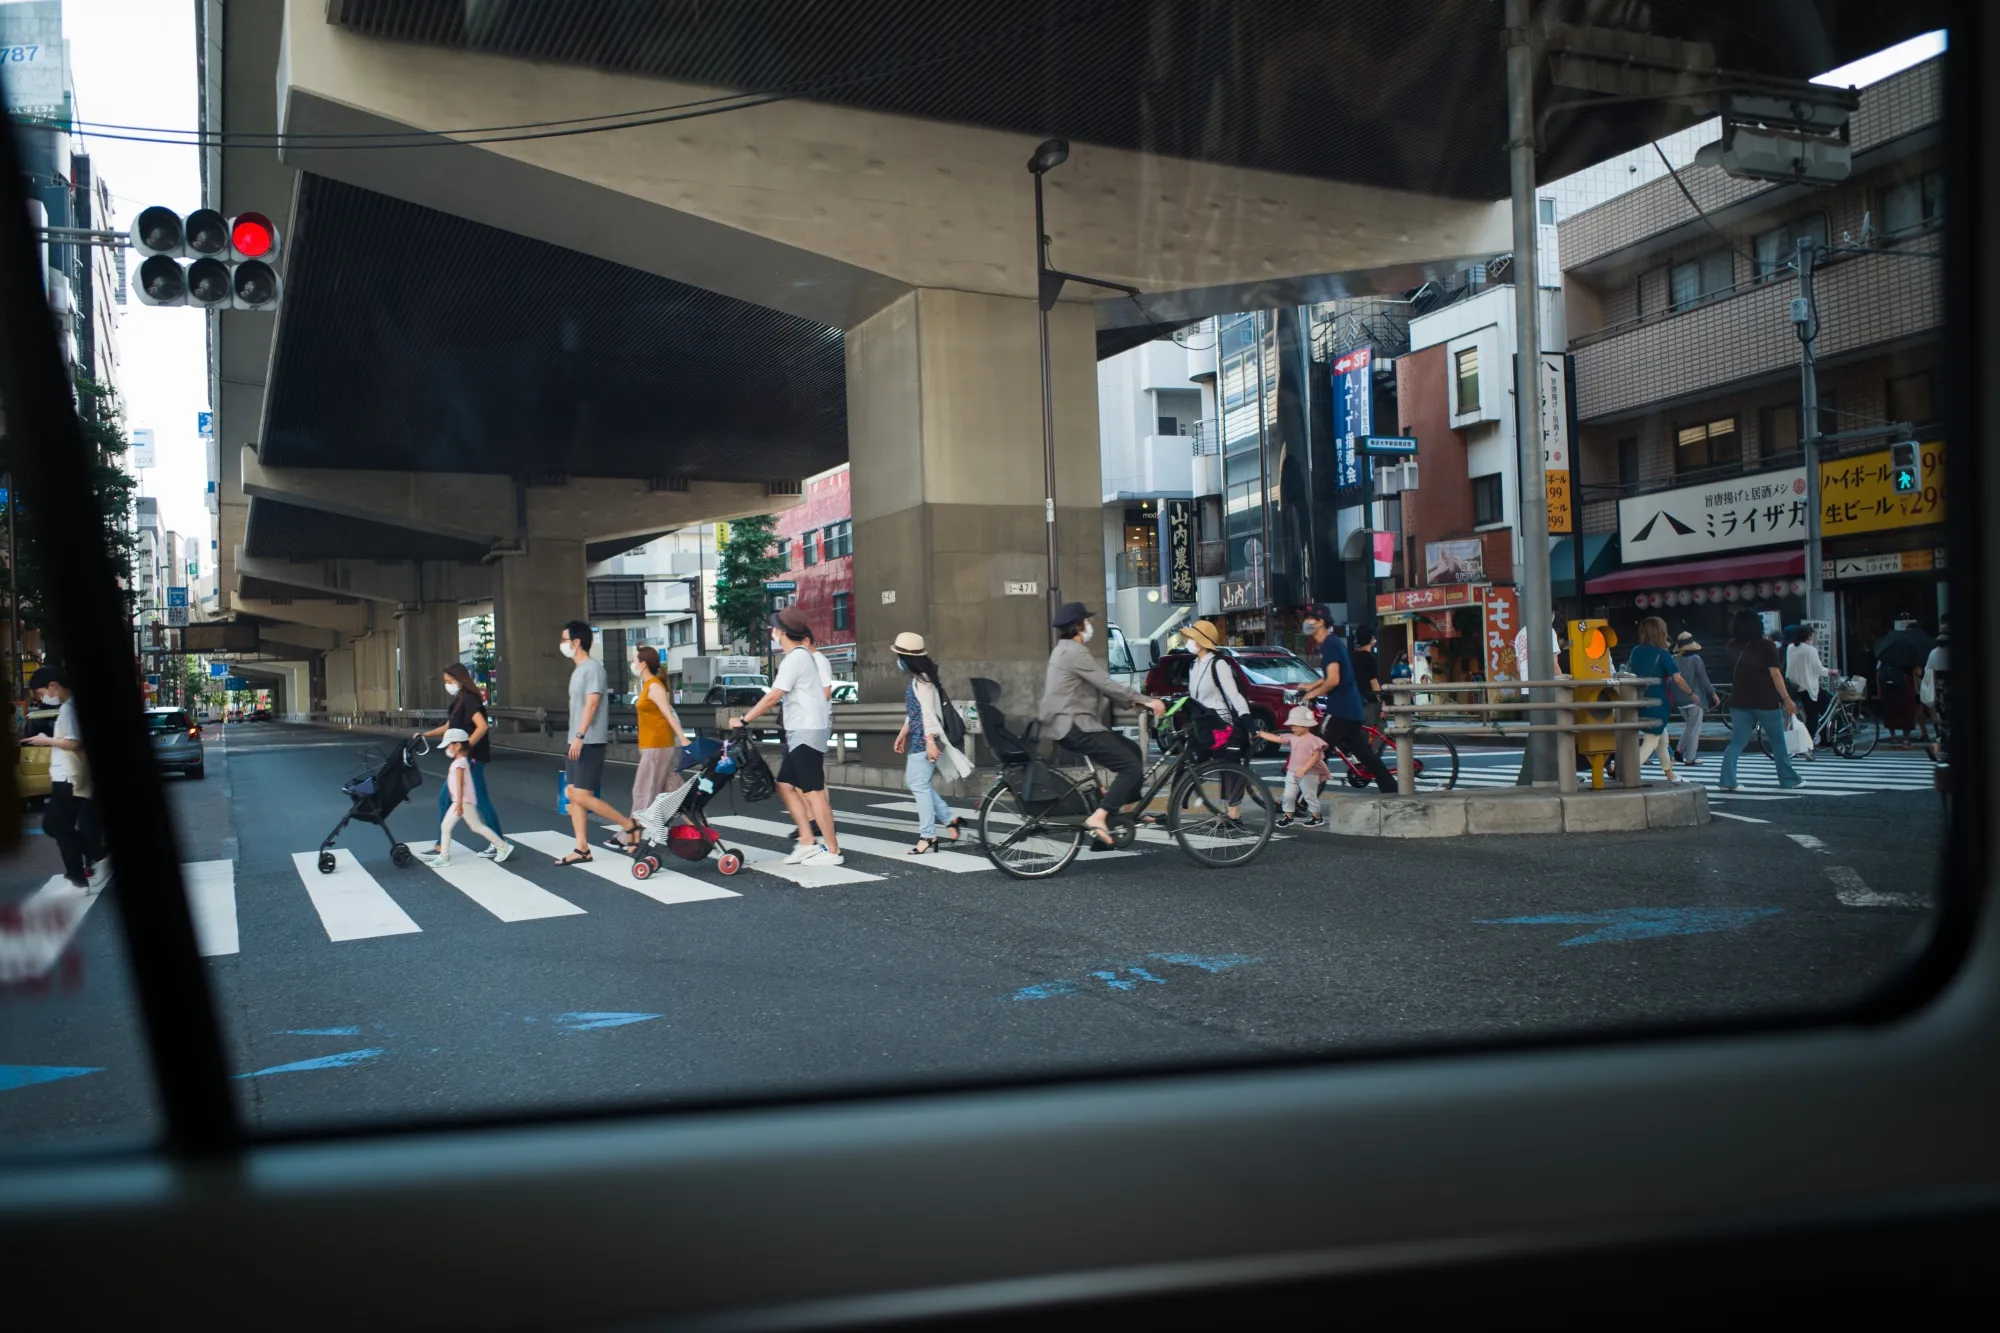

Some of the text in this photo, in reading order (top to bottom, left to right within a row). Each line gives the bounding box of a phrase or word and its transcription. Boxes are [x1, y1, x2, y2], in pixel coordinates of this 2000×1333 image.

[1823, 464, 1894, 489] ハイボール
[1704, 483, 1789, 508] 旨唐揚げと居酒メシ
[1706, 500, 1806, 538] ミライザカ
[1825, 496, 1895, 524] 生ビール
[1171, 502, 1193, 594] 山内農場
